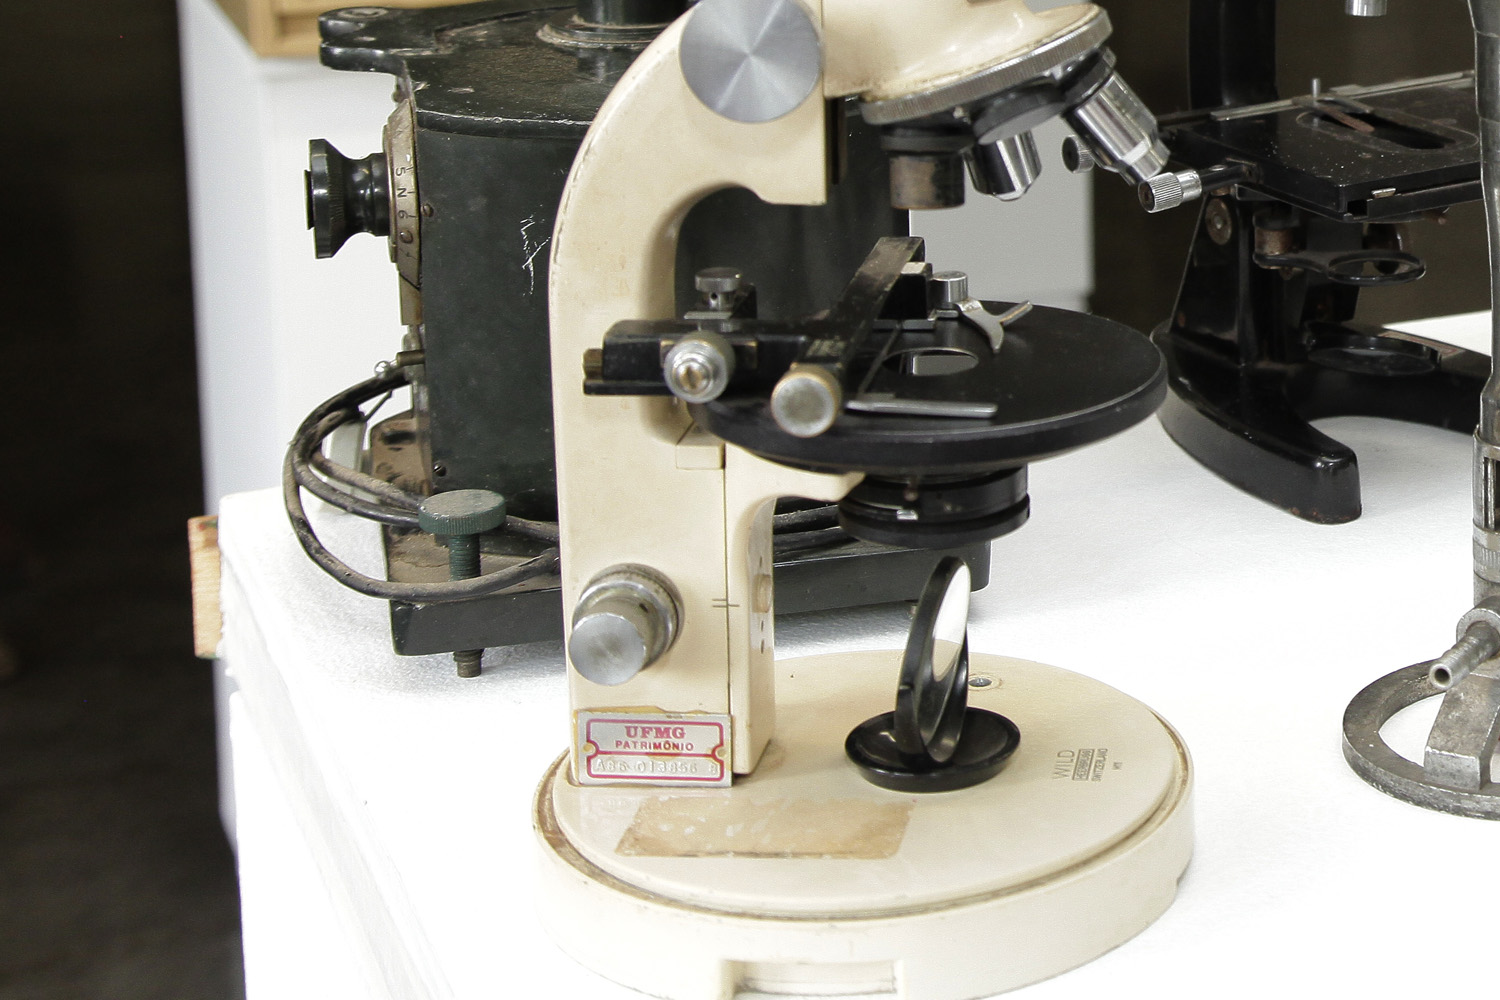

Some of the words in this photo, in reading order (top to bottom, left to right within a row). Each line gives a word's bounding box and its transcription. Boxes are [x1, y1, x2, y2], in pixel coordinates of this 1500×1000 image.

[624, 725, 687, 740] UFMG
[615, 739, 695, 752] PATRIMÔNIO
[1051, 748, 1076, 781] WILD
